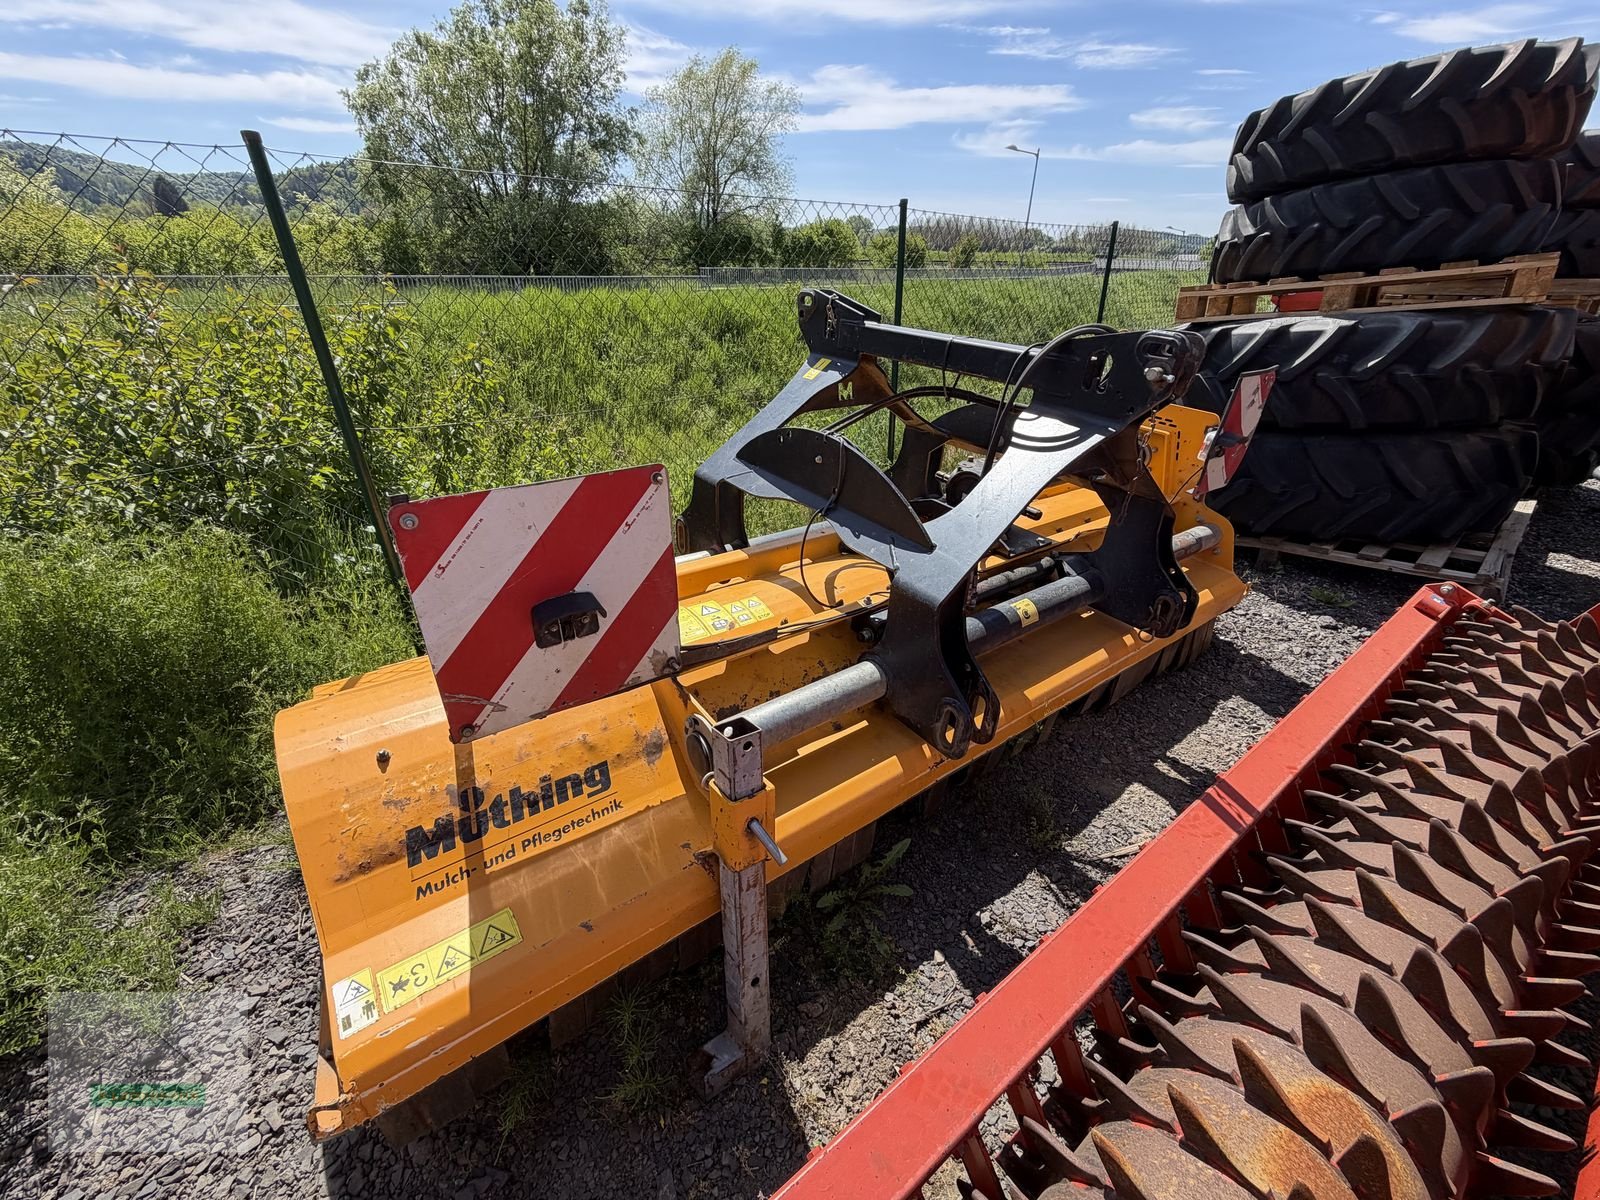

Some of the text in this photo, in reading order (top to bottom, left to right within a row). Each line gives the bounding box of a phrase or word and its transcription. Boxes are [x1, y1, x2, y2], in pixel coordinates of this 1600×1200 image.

[415, 798, 624, 901] Mulch- und Pflegetechnik
